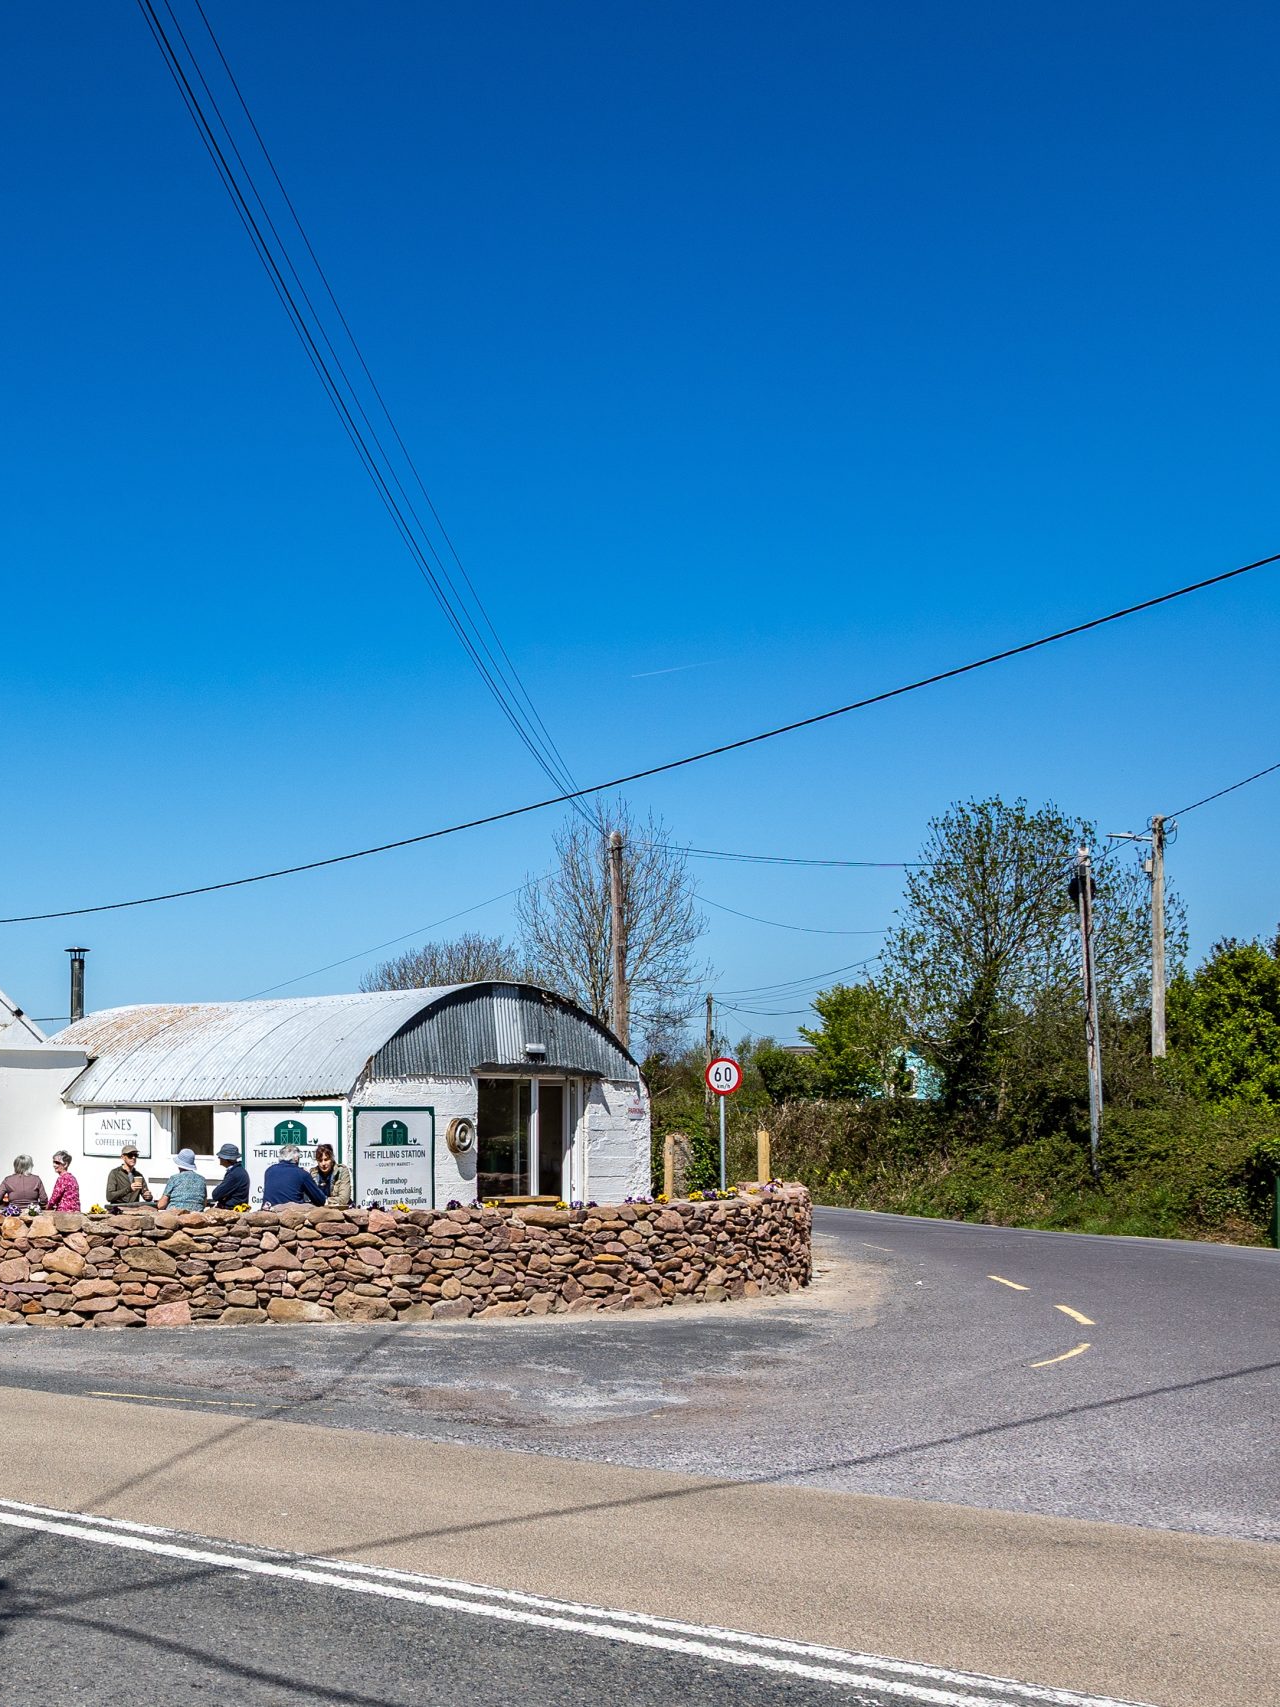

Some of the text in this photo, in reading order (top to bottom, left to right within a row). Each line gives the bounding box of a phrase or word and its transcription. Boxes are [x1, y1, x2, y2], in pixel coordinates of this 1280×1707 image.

[714, 1067, 732, 1082] 60
[100, 1118, 132, 1130] ANNE'S
[95, 1138, 137, 1147] COFFEE HATCH
[253, 1149, 267, 1158] THE
[299, 1150, 317, 1159] STAT
[363, 1150, 426, 1159] THE FILLING STATION
[381, 1177, 408, 1185] Farmshop
[366, 1188, 383, 1196] Coffee
[390, 1186, 422, 1195] Homebaking
[382, 1198, 398, 1206] Plants
[405, 1197, 427, 1206] Supplies
